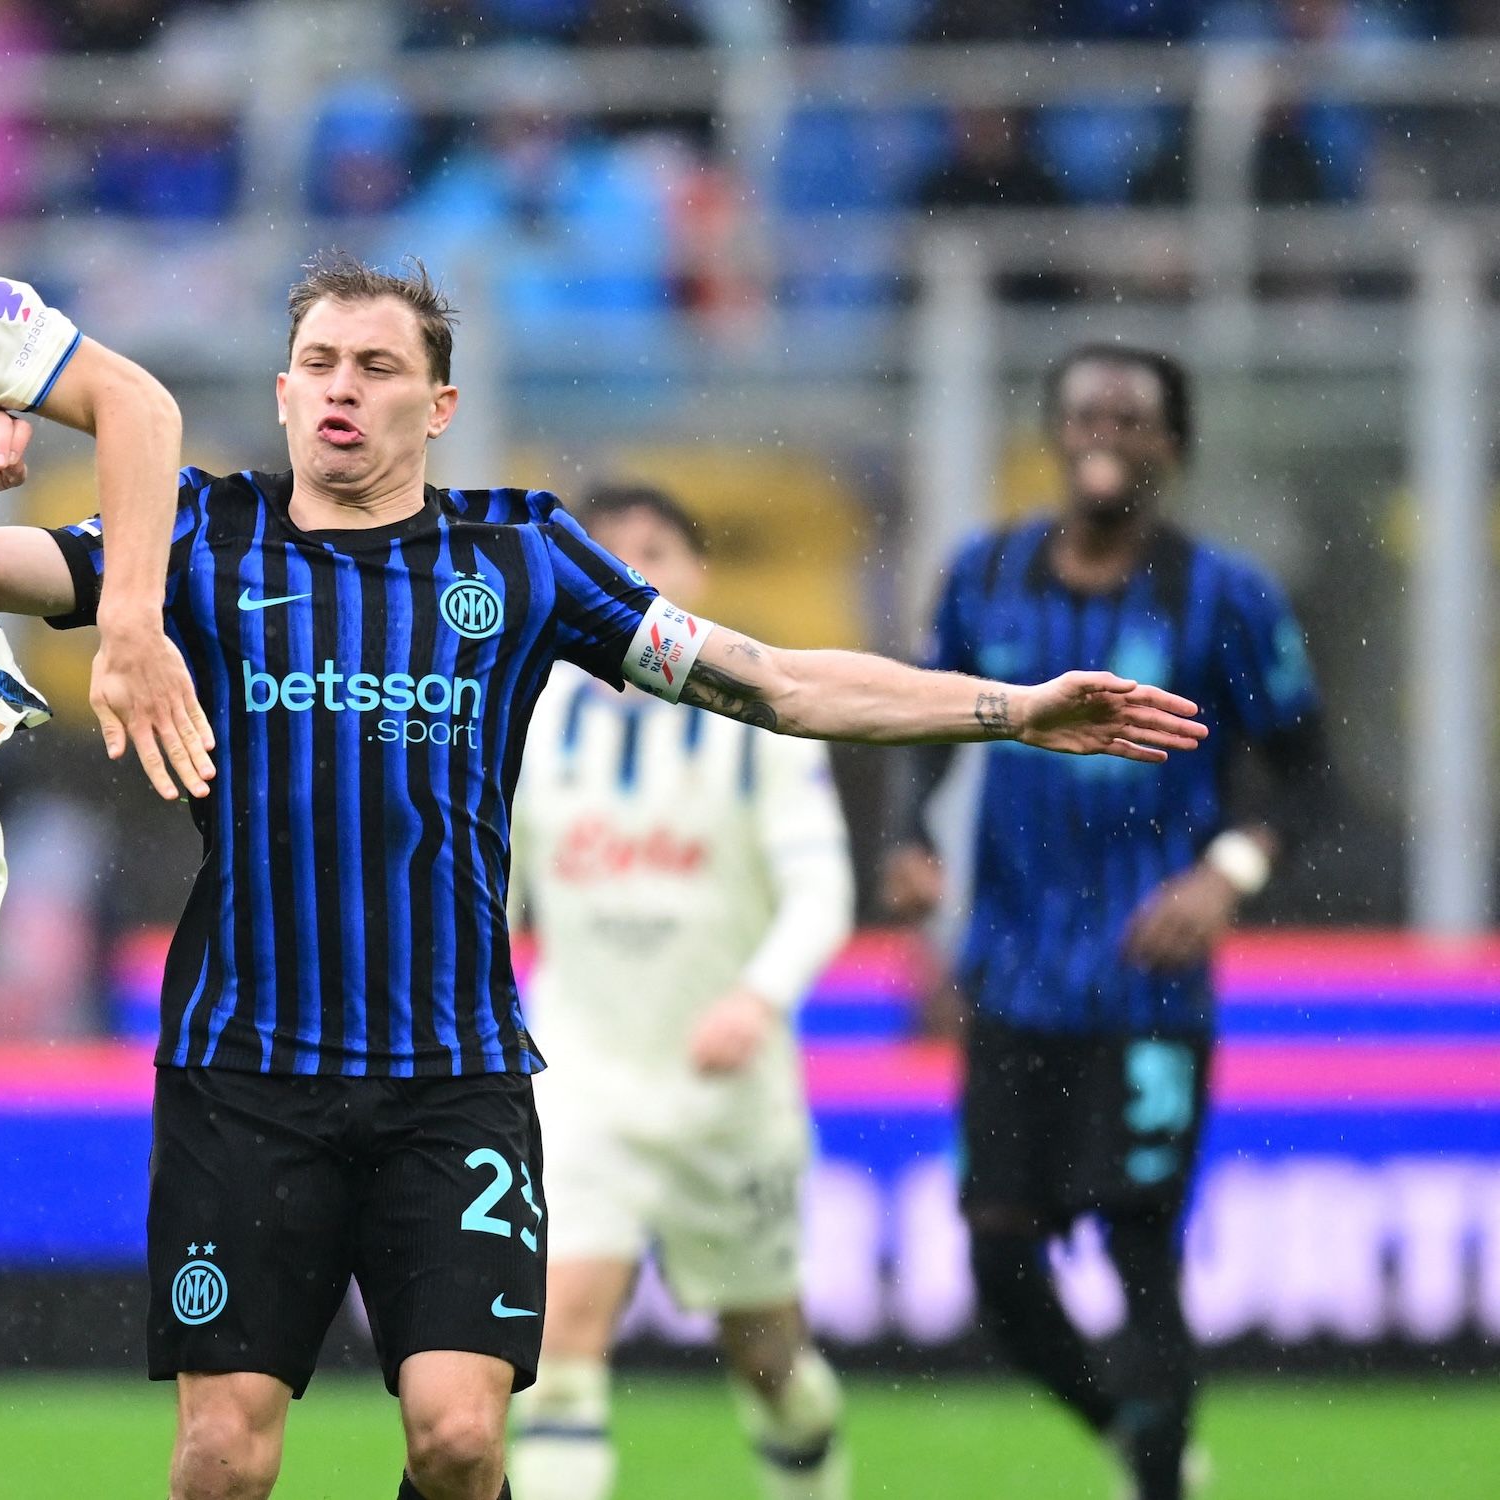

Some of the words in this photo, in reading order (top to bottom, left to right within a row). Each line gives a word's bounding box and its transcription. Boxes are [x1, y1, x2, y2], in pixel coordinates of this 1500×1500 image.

[638, 645, 654, 668] KEEP
[650, 637, 673, 673] RACISM
[669, 642, 684, 662] OUT
[242, 659, 481, 718] betsson
[367, 718, 477, 750] .sport
